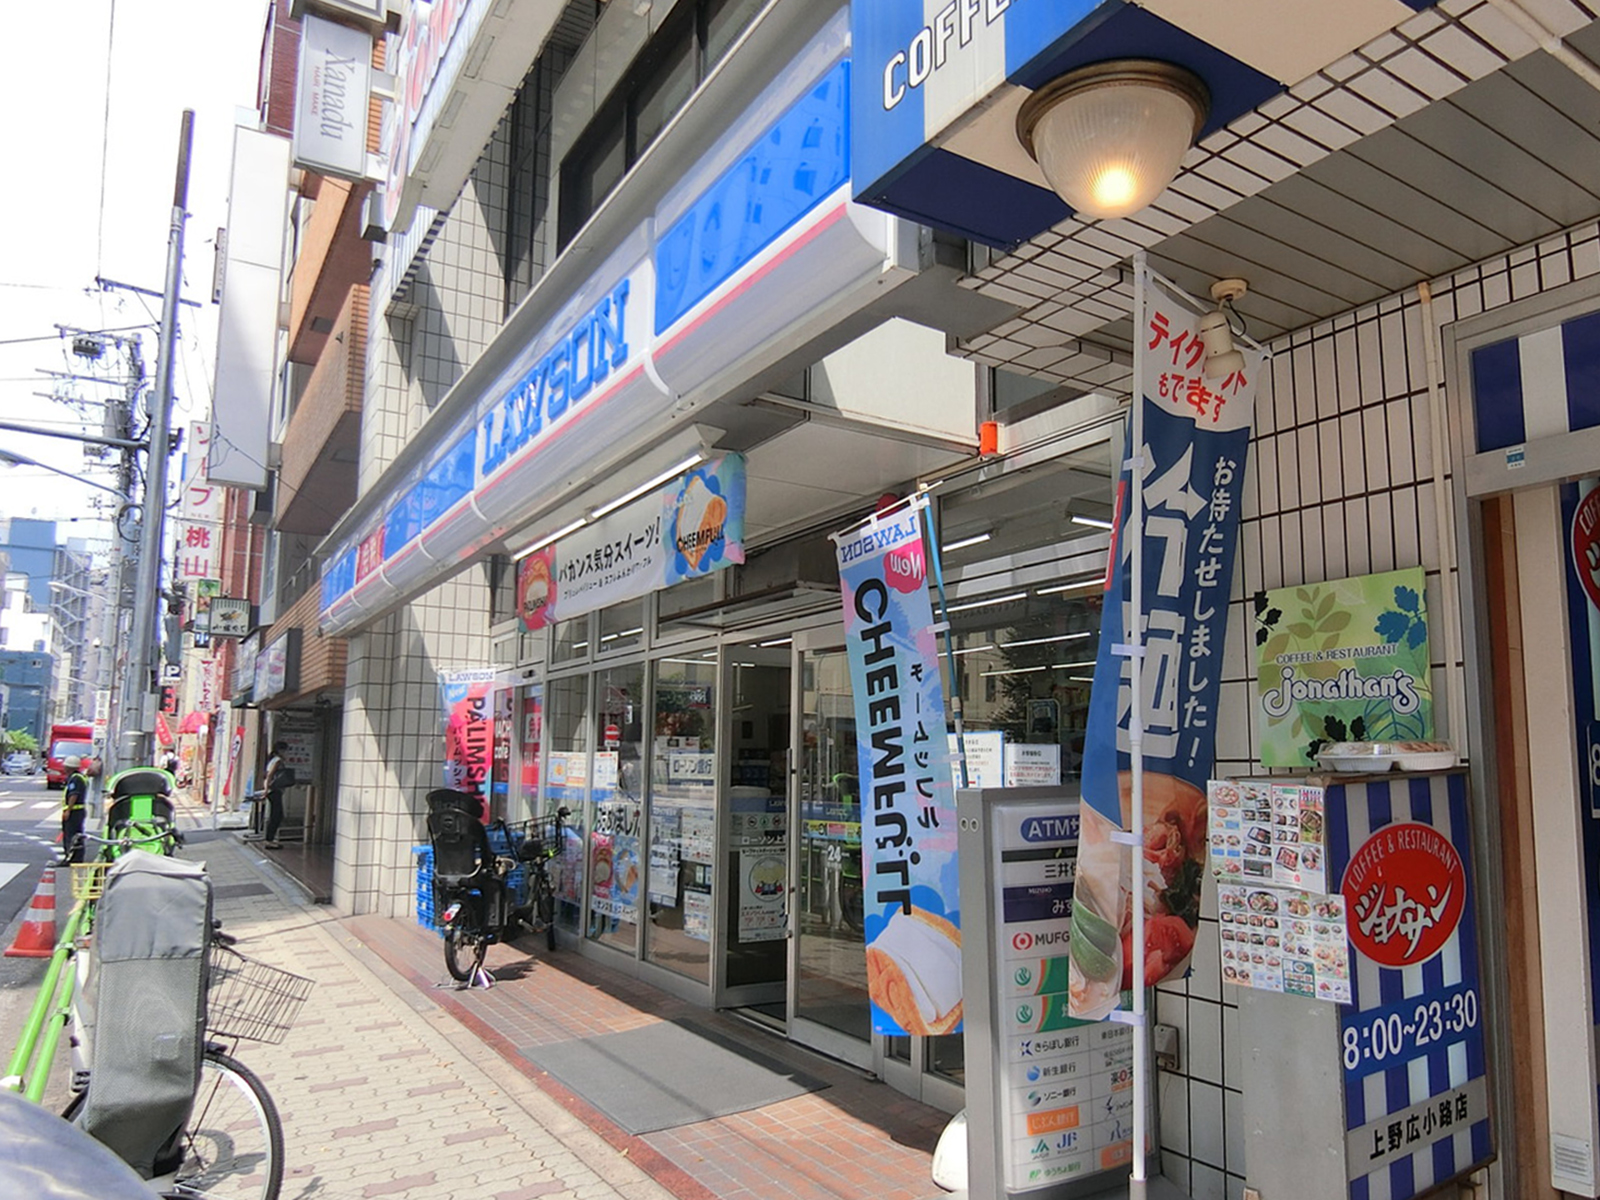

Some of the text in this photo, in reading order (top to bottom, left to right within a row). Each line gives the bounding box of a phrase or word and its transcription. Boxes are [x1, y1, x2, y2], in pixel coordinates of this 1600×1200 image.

[320, 48, 356, 141] Xanadu
[482, 279, 630, 475] LAWSON
[1148, 311, 1248, 396] テイクト
[1158, 371, 1227, 424] もできます
[184, 525, 210, 578] 桃山
[559, 515, 661, 584] バカンス気分スイーツ!
[1184, 456, 1236, 768] お待たせしました!
[166, 665, 180, 677] P
[1276, 643, 1398, 664] COFFEE & RESTAURANT
[466, 697, 486, 799] PALIMSH
[827, 845, 841, 862] 24
[1348, 829, 1458, 892] COFFEE & RESTAURANT
[1035, 932, 1070, 945] MUFG
[1354, 880, 1453, 960] ジョナサン
[1034, 1036, 1080, 1053] きらぼし銀行
[1043, 1062, 1076, 1077] 新生銀行
[1044, 1087, 1076, 1102] ソニー銀行
[1370, 1093, 1468, 1160] 上野広小路店
